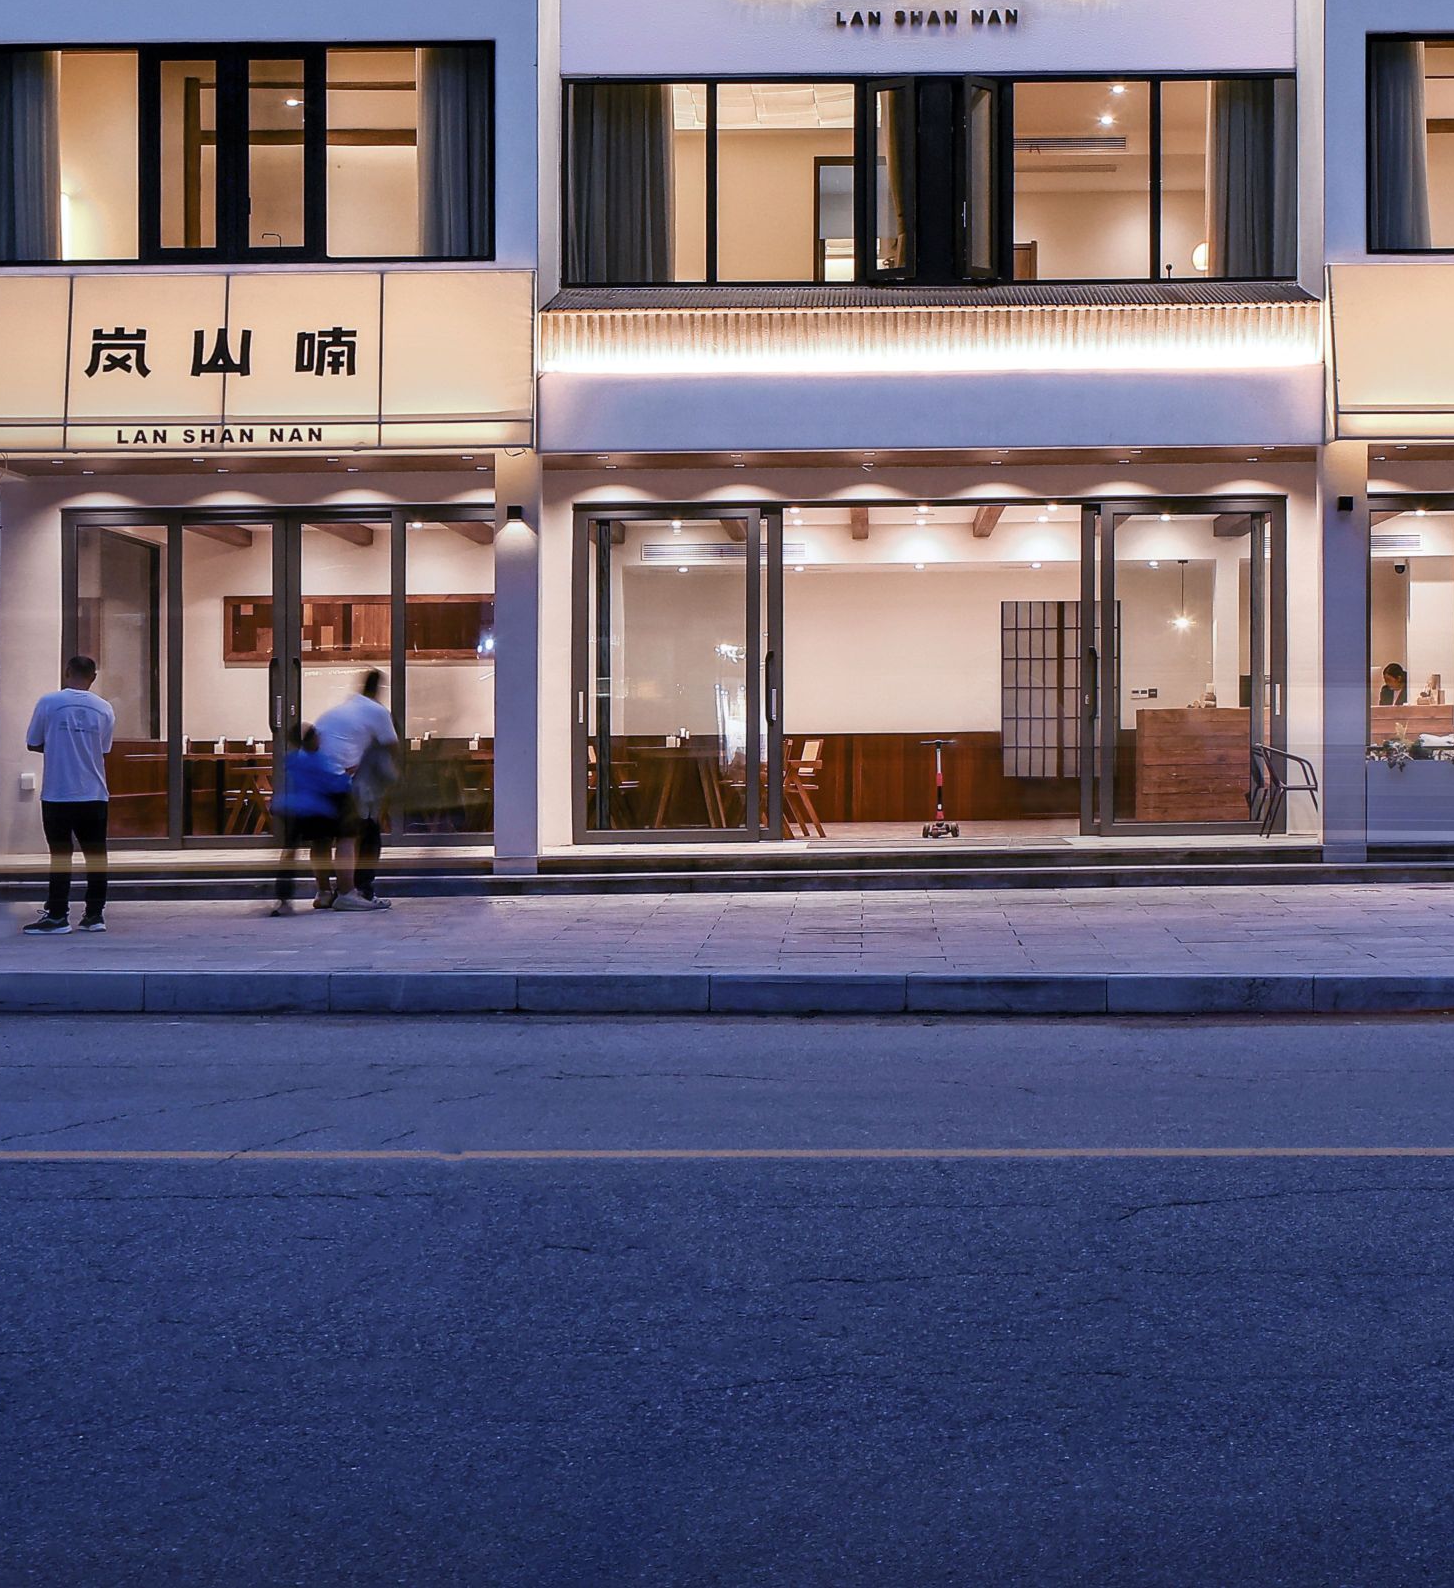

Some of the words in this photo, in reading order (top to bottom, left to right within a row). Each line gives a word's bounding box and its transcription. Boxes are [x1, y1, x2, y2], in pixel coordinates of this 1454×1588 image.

[836, 11, 881, 28] LAN
[894, 10, 958, 28] SHAN
[971, 9, 1019, 26] NAN
[84, 326, 358, 379] 岚山喃
[117, 428, 168, 445] LAN
[182, 428, 254, 444] SHAN
[269, 426, 324, 443] NAN
